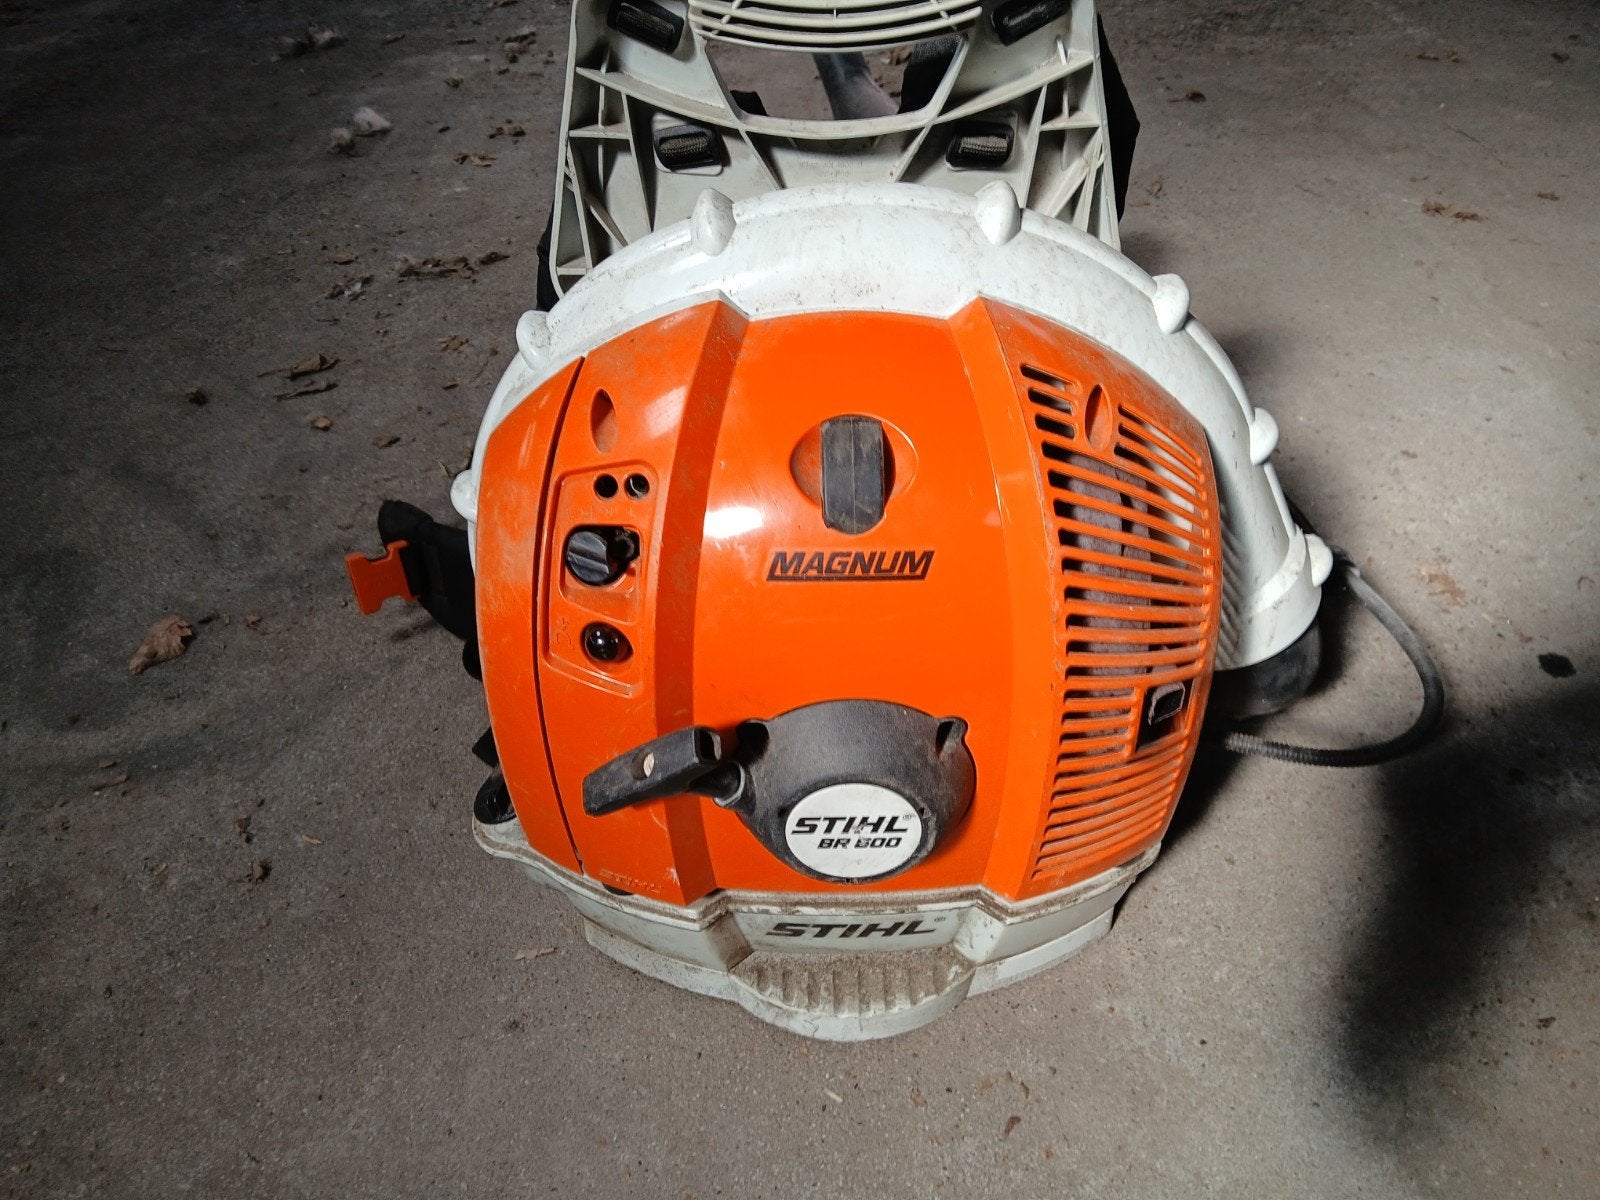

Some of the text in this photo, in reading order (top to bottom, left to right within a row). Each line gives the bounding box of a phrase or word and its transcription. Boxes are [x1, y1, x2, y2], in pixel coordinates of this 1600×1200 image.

[766, 550, 935, 581] MAGNUM
[791, 816, 908, 834] STIHL
[817, 837, 850, 849] BR
[766, 920, 936, 938] STIHL
